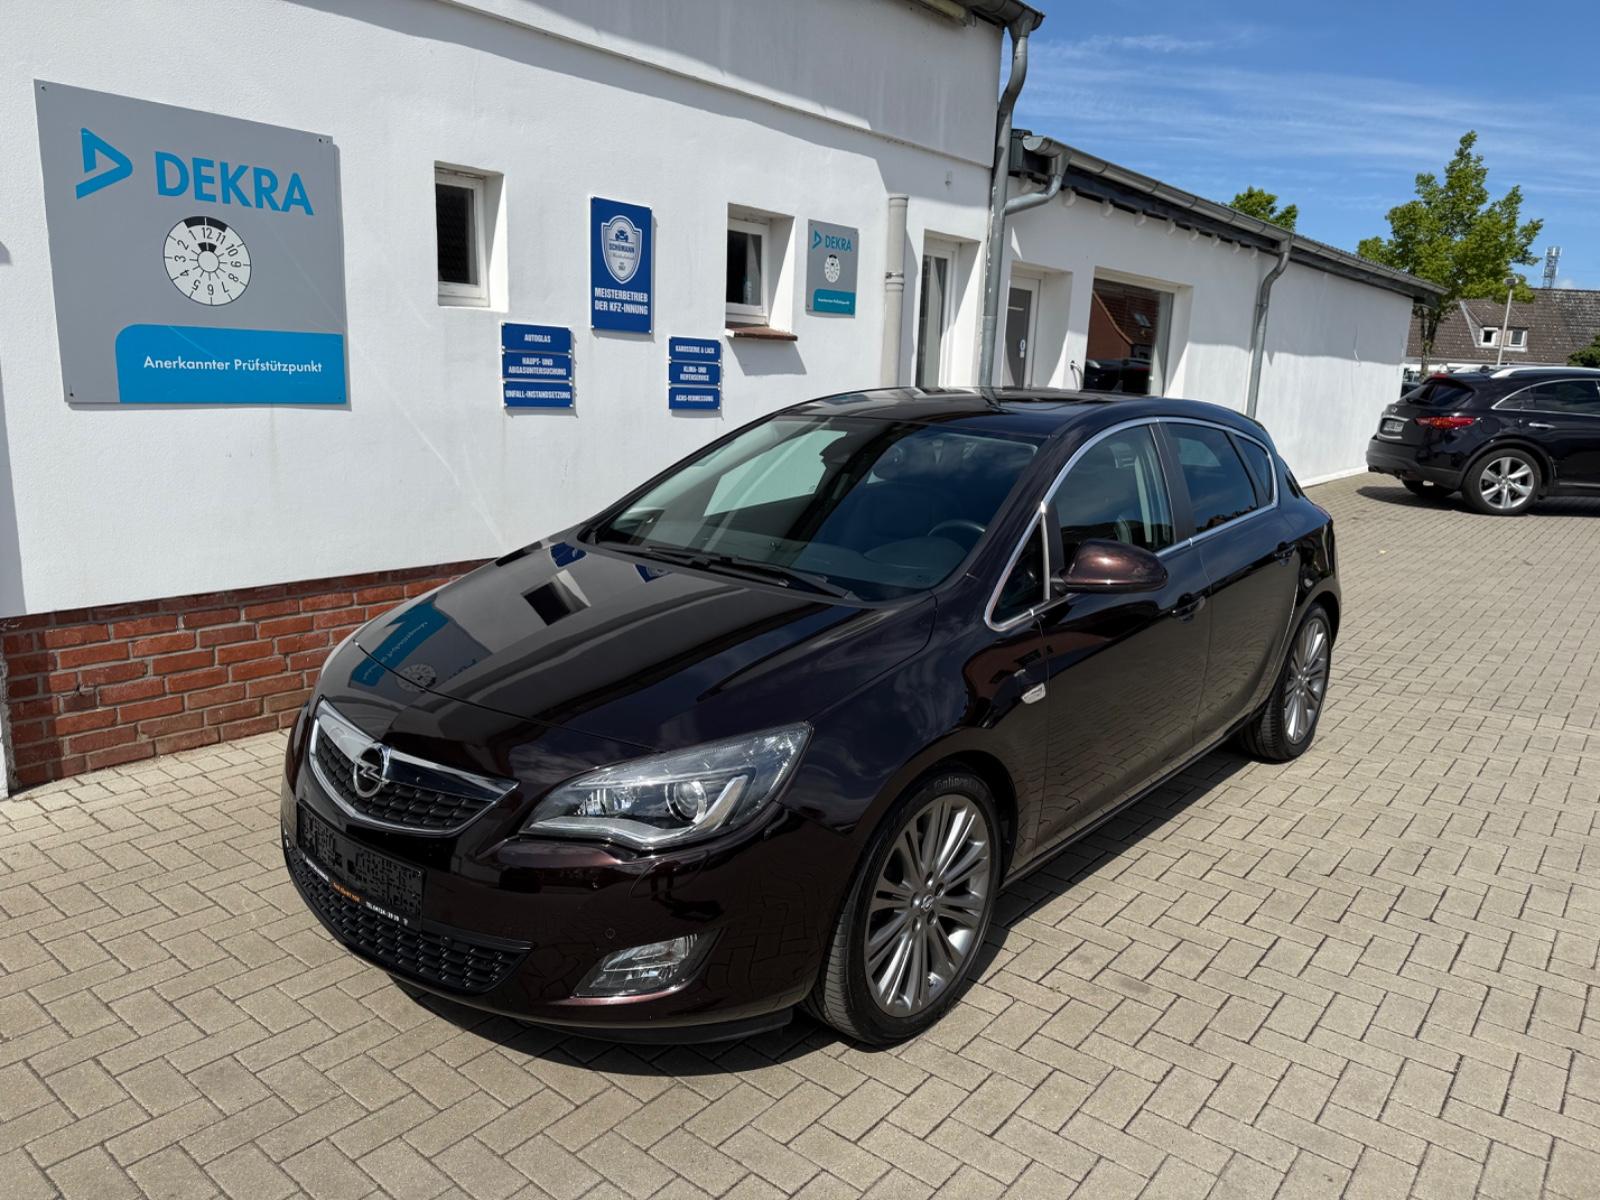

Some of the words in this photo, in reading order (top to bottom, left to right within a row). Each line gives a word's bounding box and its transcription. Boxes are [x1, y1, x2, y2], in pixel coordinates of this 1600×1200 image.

[155, 151, 315, 216] DEKRA
[201, 227, 213, 239] 12
[216, 232, 226, 245] 11
[177, 240, 189, 250] 2
[825, 235, 852, 252] DEKRA
[226, 244, 238, 257] 10
[174, 255, 186, 263] 3
[228, 273, 239, 282] 8
[192, 280, 201, 291] 5
[221, 281, 229, 293] 7
[594, 287, 648, 302] MEISTERBETRIEB
[594, 300, 608, 311] DER
[609, 301, 648, 315] KFZ-INNUNG
[524, 334, 551, 343] AUTOGLAS
[143, 355, 230, 371] Anerkannter
[234, 357, 323, 375] Prüfstützpunkt
[522, 357, 541, 365] HAUPT-
[541, 358, 553, 366] UND
[508, 366, 567, 376] ABGASUNTERSUCHUNG
[505, 390, 571, 399] UNFALL-INSTANDSETZUNG
